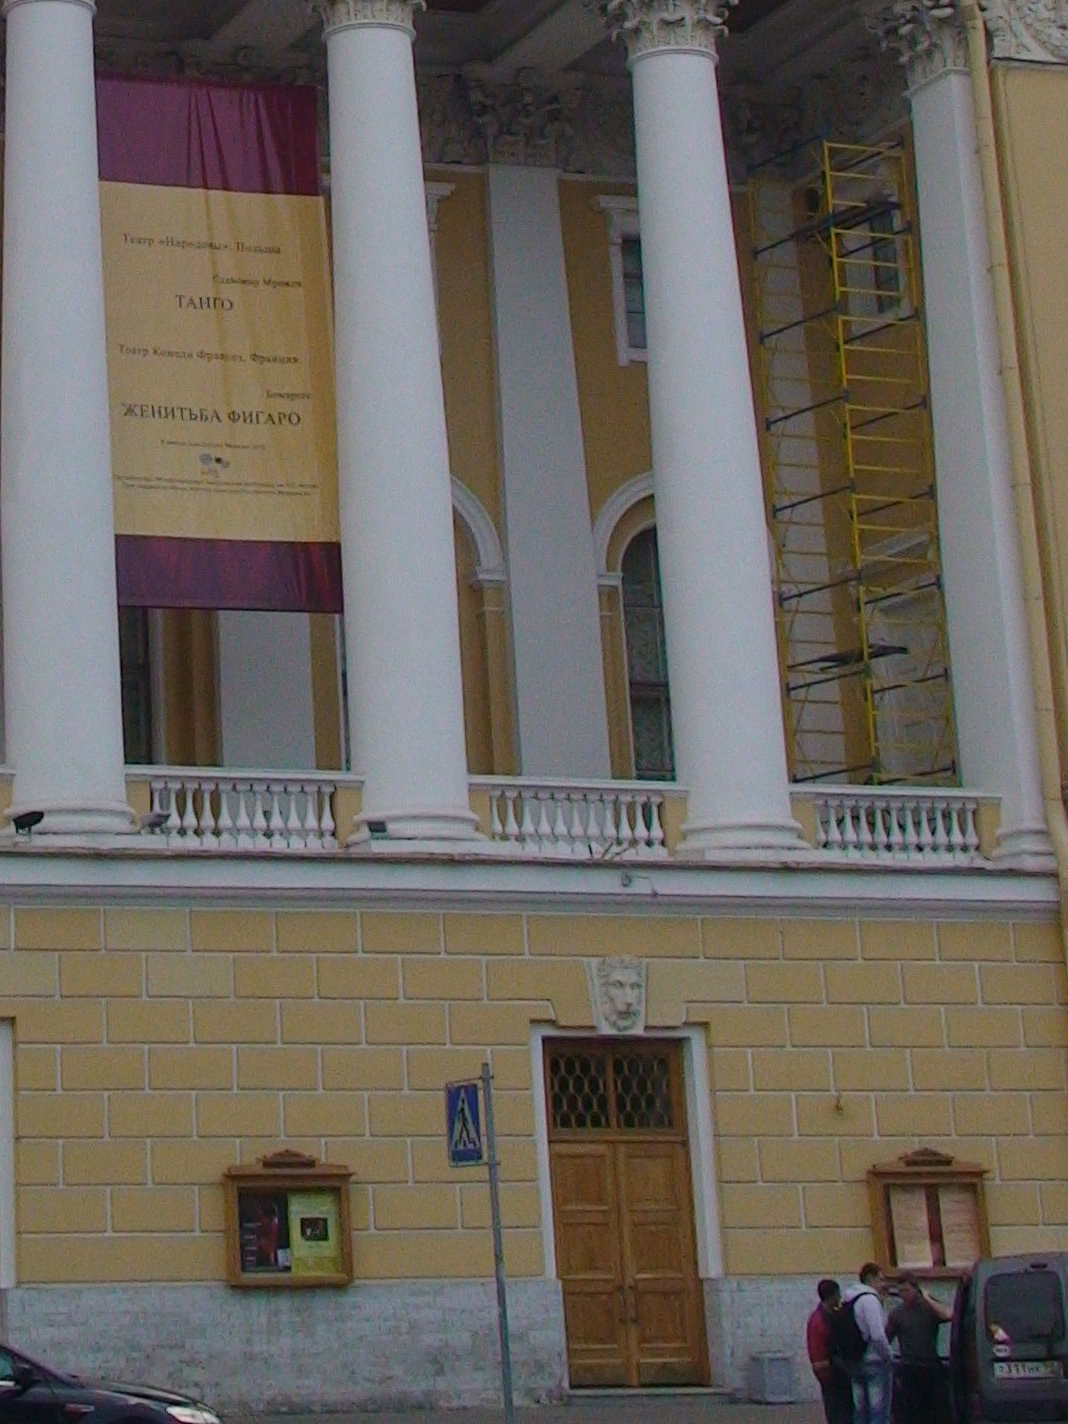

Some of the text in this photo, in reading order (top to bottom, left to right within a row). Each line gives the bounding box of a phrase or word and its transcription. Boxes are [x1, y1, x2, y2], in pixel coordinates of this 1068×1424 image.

[175, 294, 234, 312] ТАНГО
[122, 402, 301, 427] ЖЕНИТЬБА ФИГАРО
